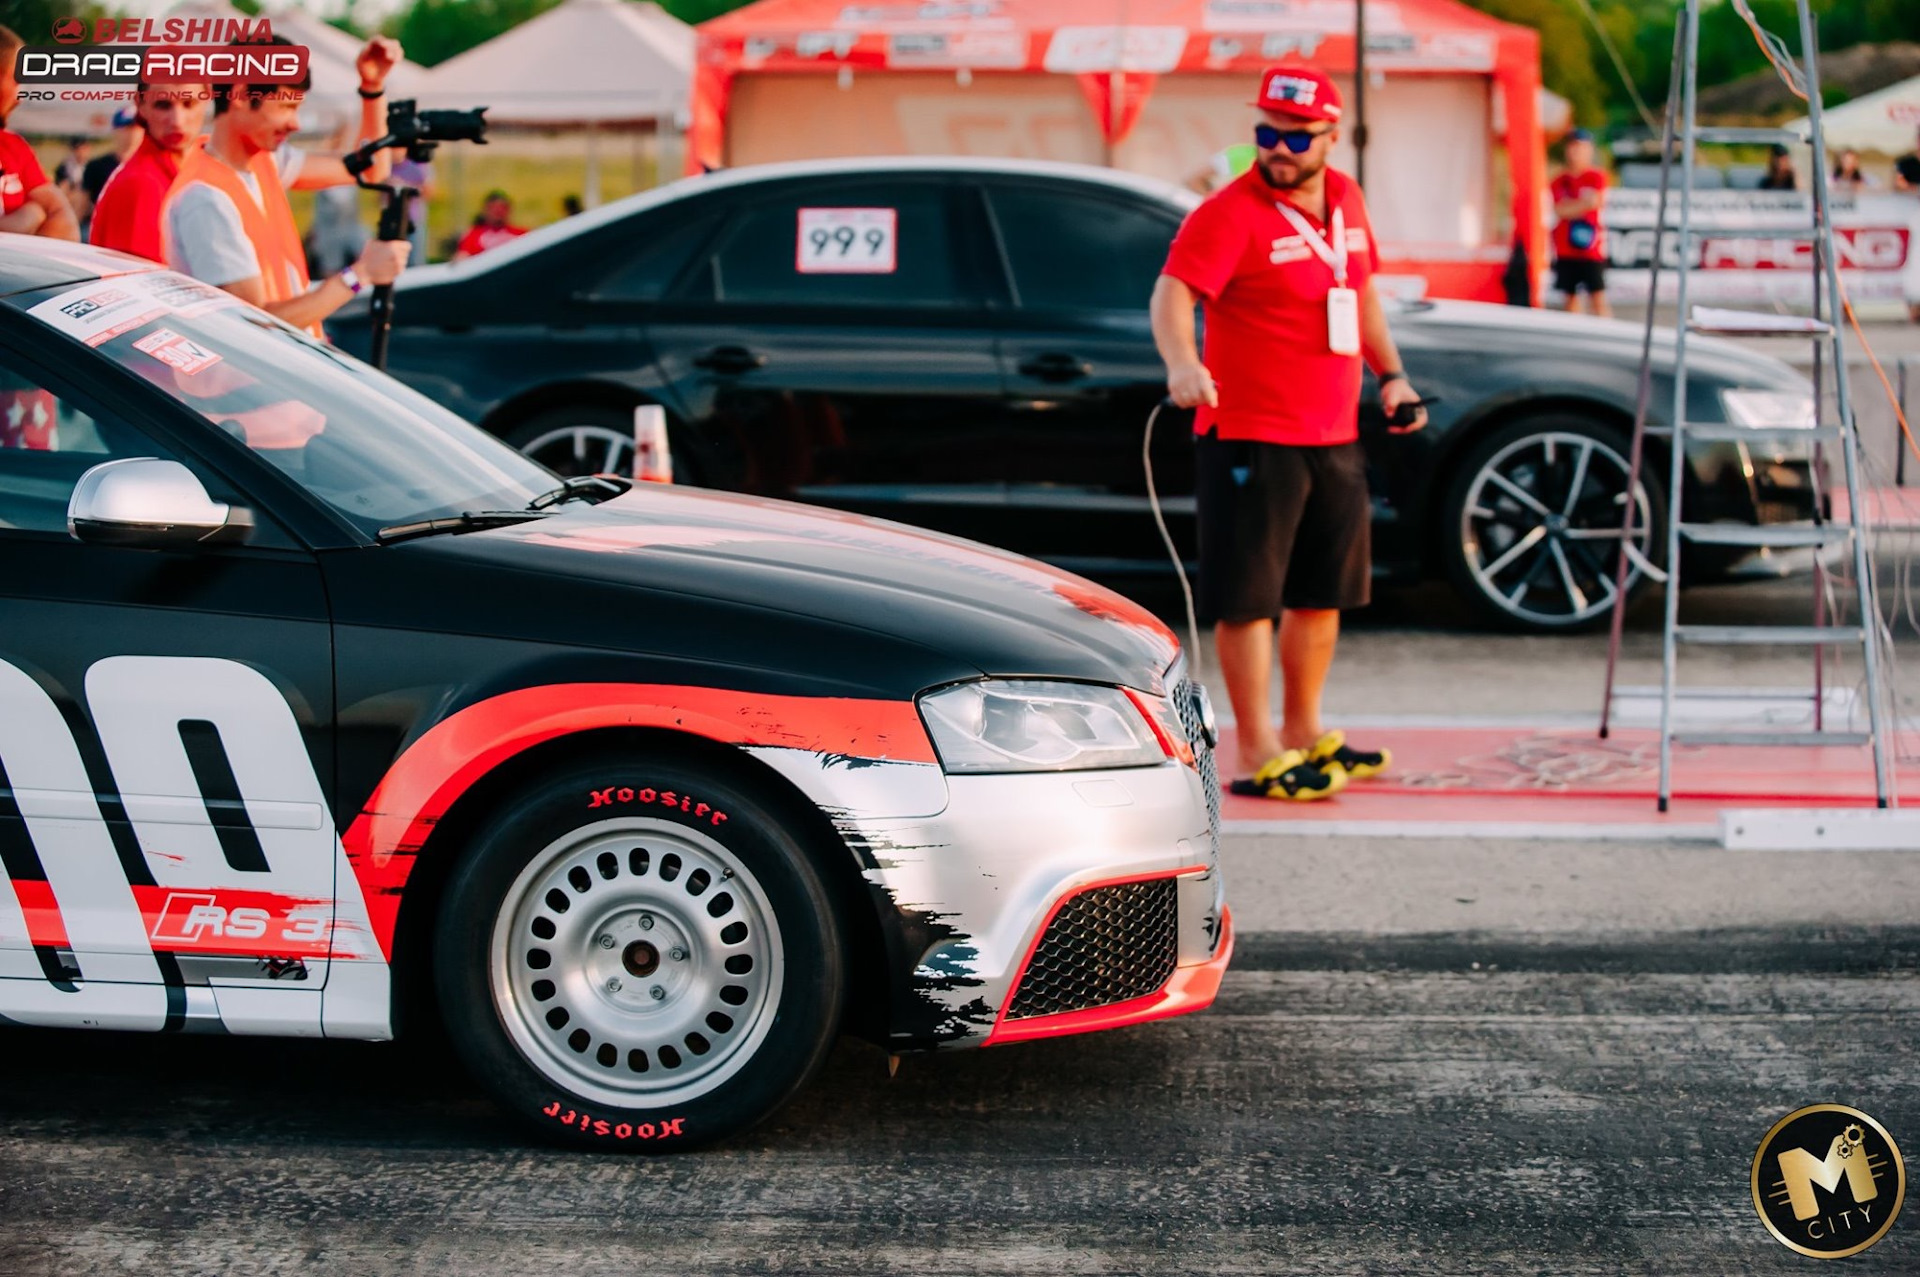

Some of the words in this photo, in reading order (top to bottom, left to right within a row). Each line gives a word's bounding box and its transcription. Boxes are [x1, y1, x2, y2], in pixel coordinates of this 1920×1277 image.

[810, 226, 884, 256] 999
[588, 786, 728, 826] Hoosier
[172, 899, 270, 939] RS
[281, 908, 328, 941] 3
[543, 1102, 686, 1140] Hoosier
